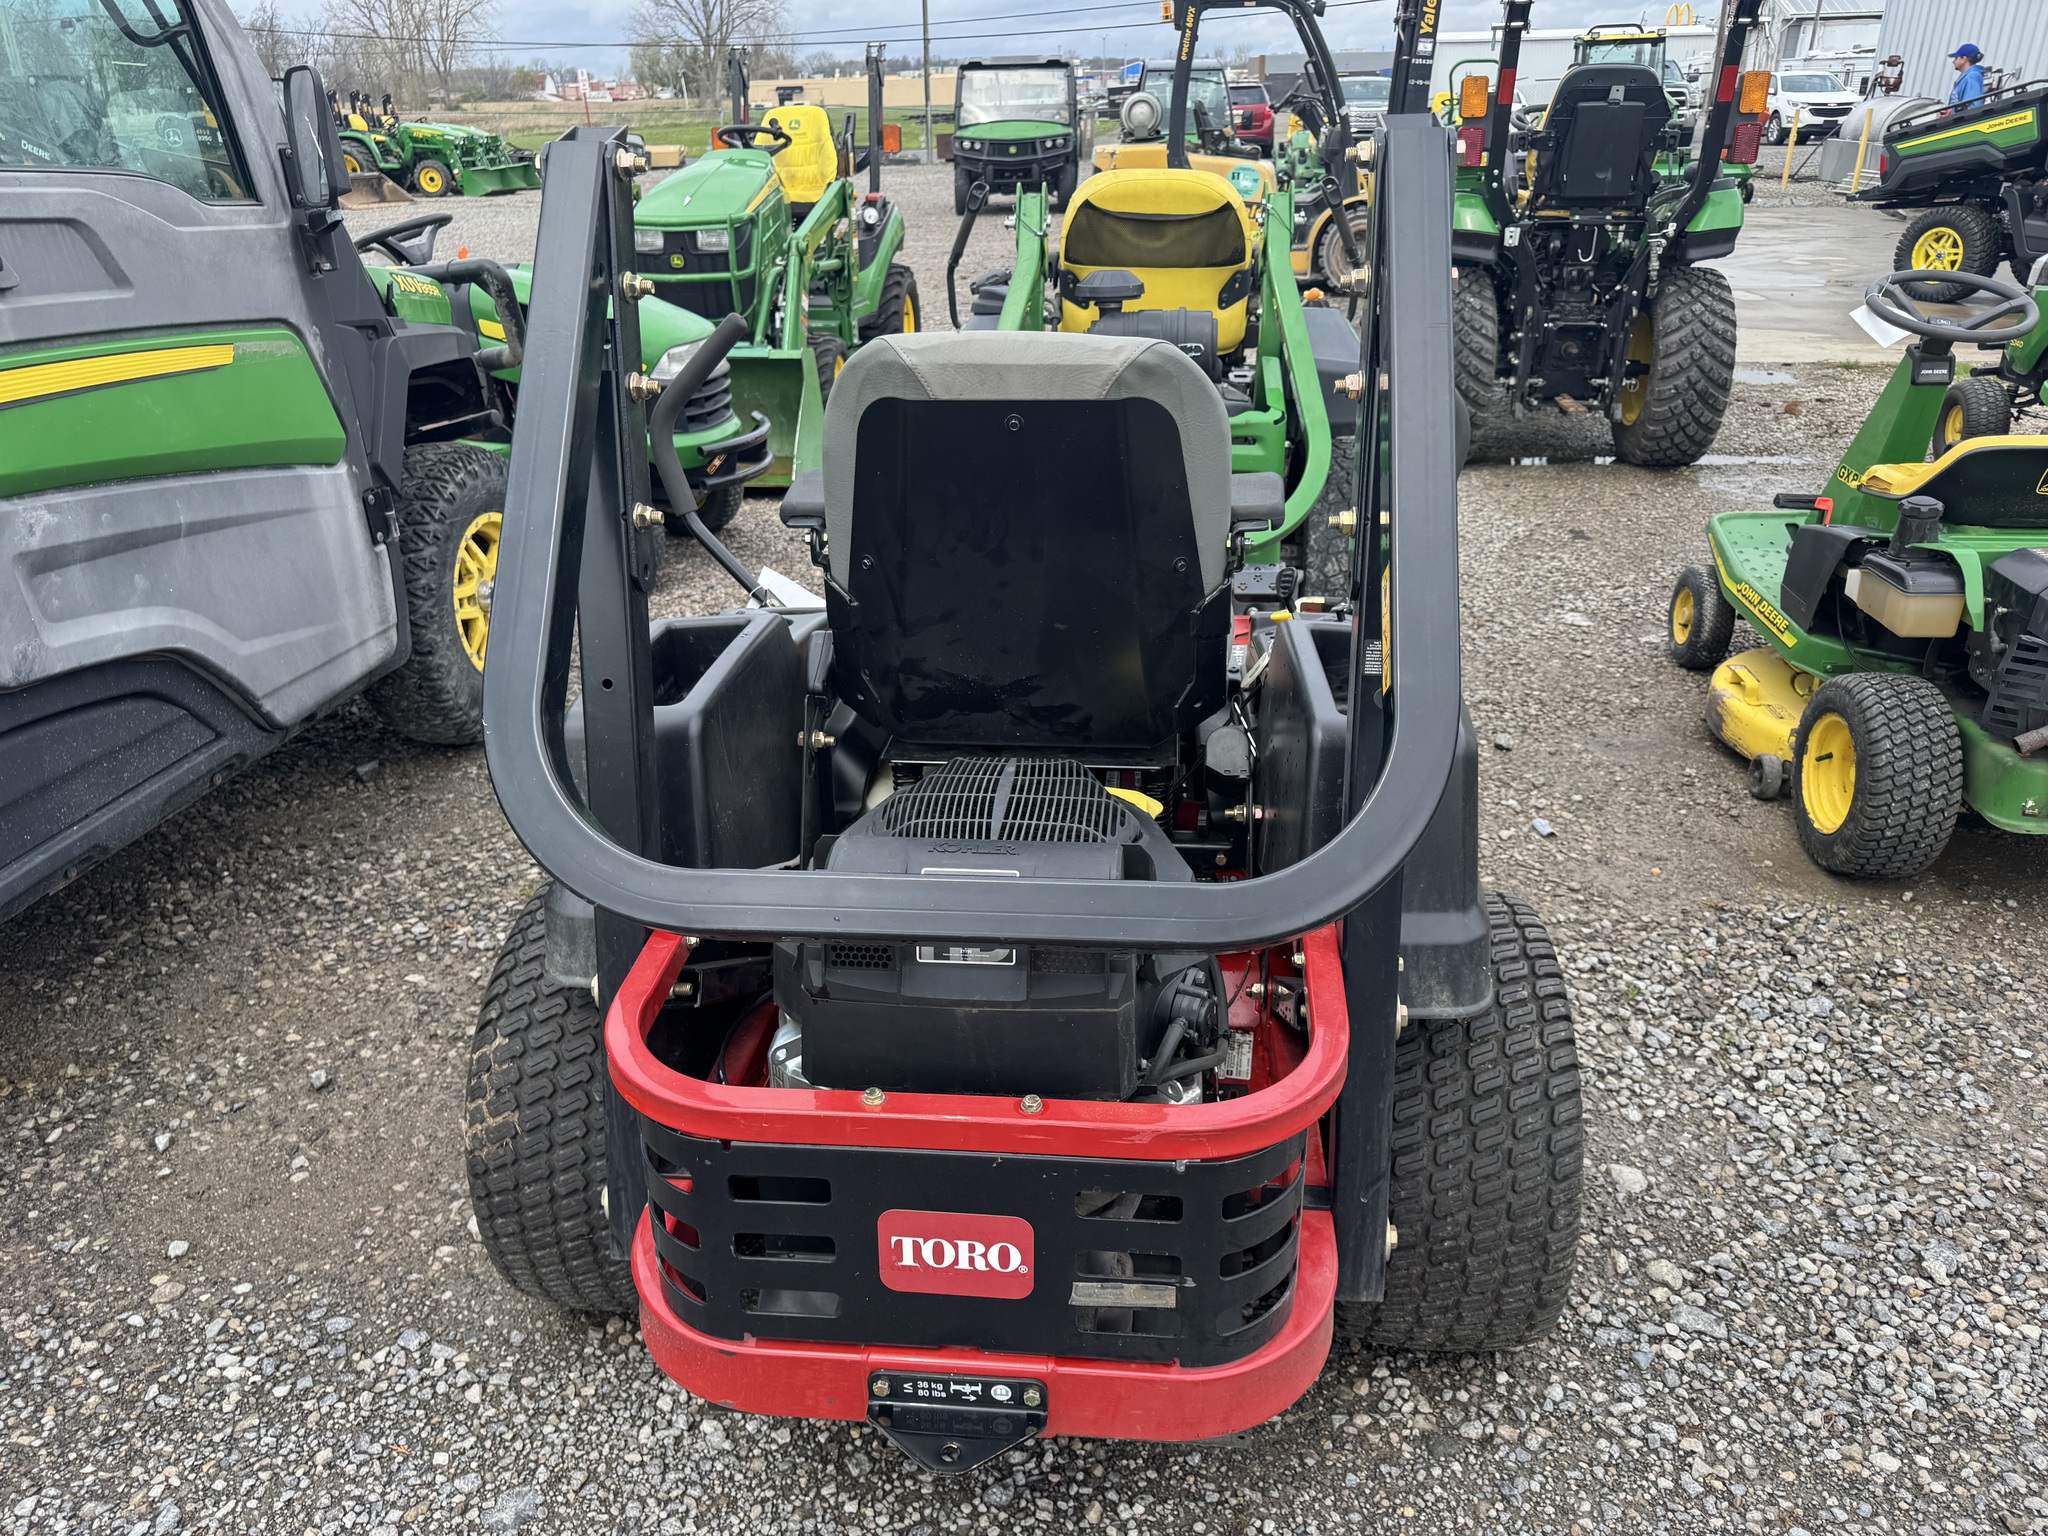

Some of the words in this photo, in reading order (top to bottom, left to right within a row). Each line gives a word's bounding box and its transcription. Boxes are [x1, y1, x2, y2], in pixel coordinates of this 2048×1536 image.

[1186, 6, 1196, 28] 60VX
[1419, 0, 1437, 34] Yale
[1986, 121, 2004, 130] JOHN
[2005, 115, 2028, 125] DEERE
[21, 139, 50, 161] DEERE
[1736, 581, 1762, 607] JOHN
[1758, 600, 1790, 634] DEERE
[927, 842, 1017, 856] KOHLER
[917, 1381, 929, 1389] 36
[931, 1381, 943, 1391] kg
[917, 1389, 930, 1397] 80
[931, 1390, 947, 1398] lbs
